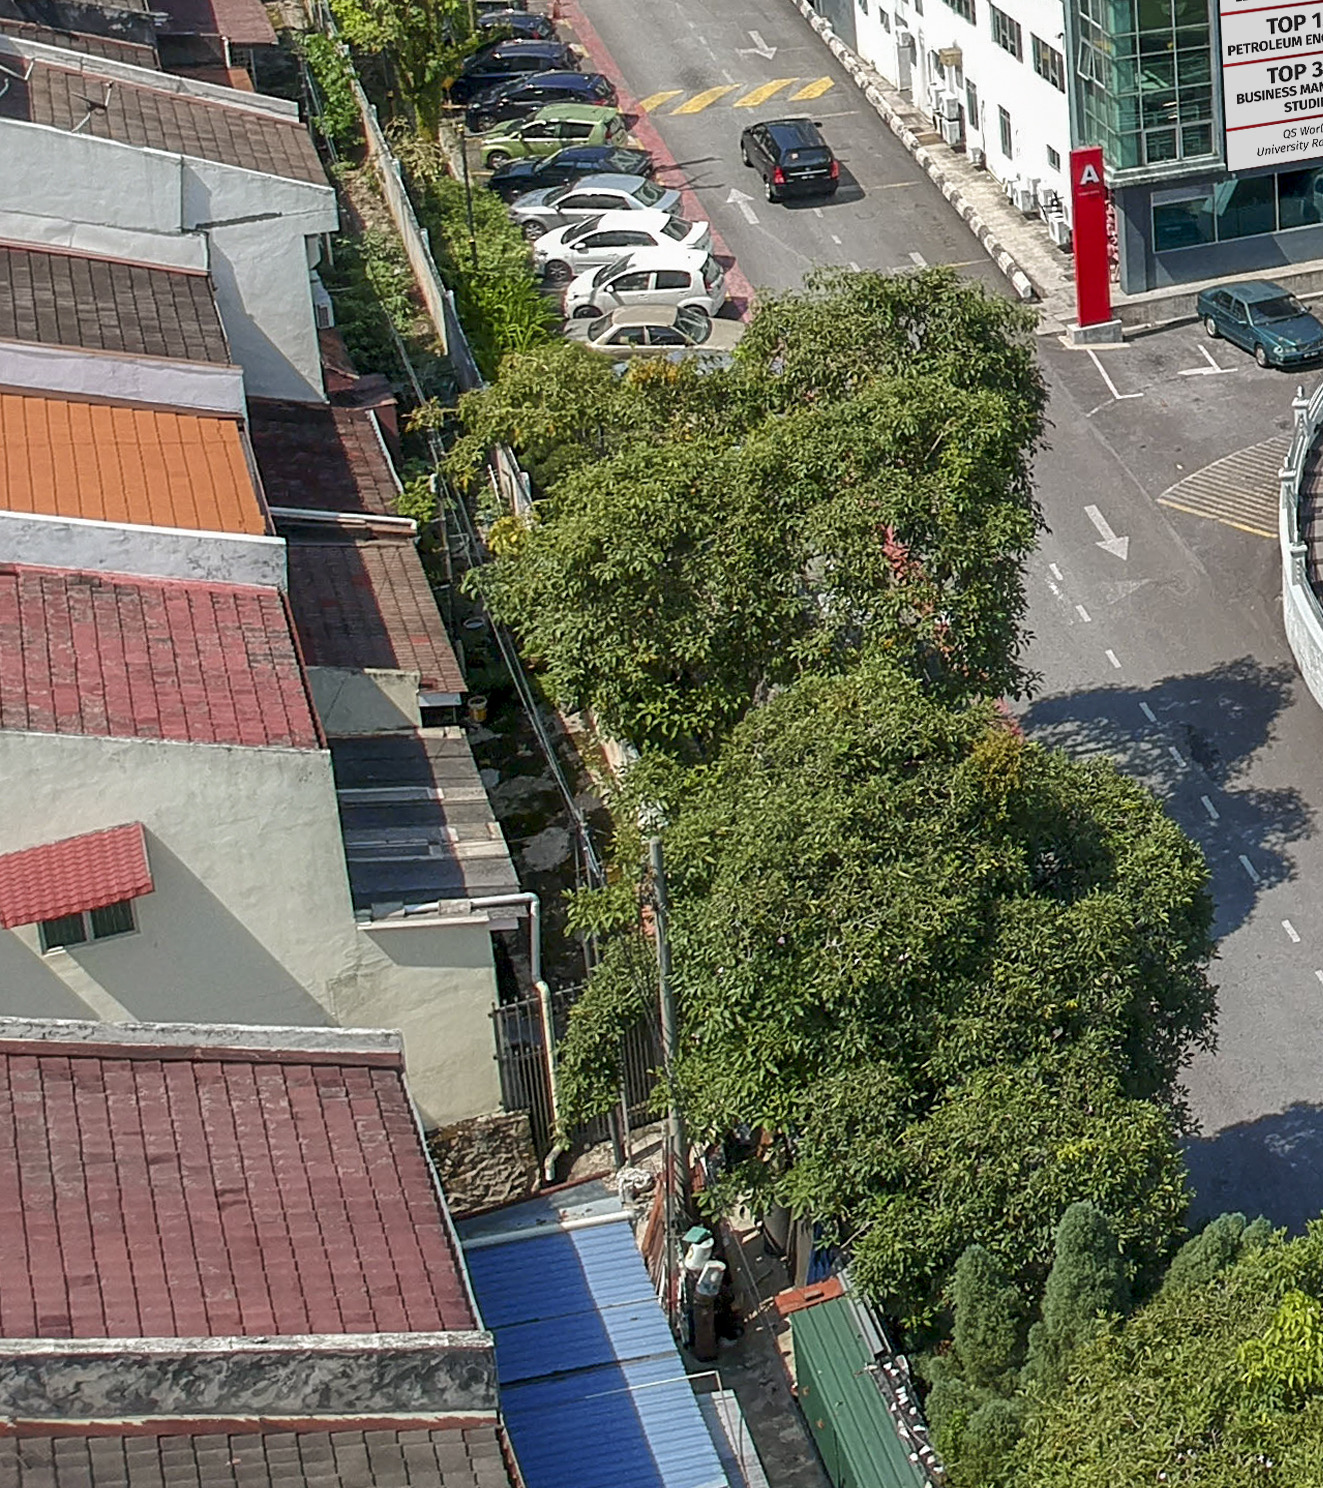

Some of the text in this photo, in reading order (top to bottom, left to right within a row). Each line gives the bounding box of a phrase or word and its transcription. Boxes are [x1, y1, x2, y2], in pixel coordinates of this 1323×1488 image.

[1266, 15, 1306, 35] TOP
[1227, 36, 1302, 56] PETROLEUM
[1267, 63, 1307, 84] TOP
[1236, 85, 1297, 105] BUSINESS
[1283, 128, 1297, 140] QS
[1256, 141, 1310, 157] University
[1080, 164, 1100, 186] A
